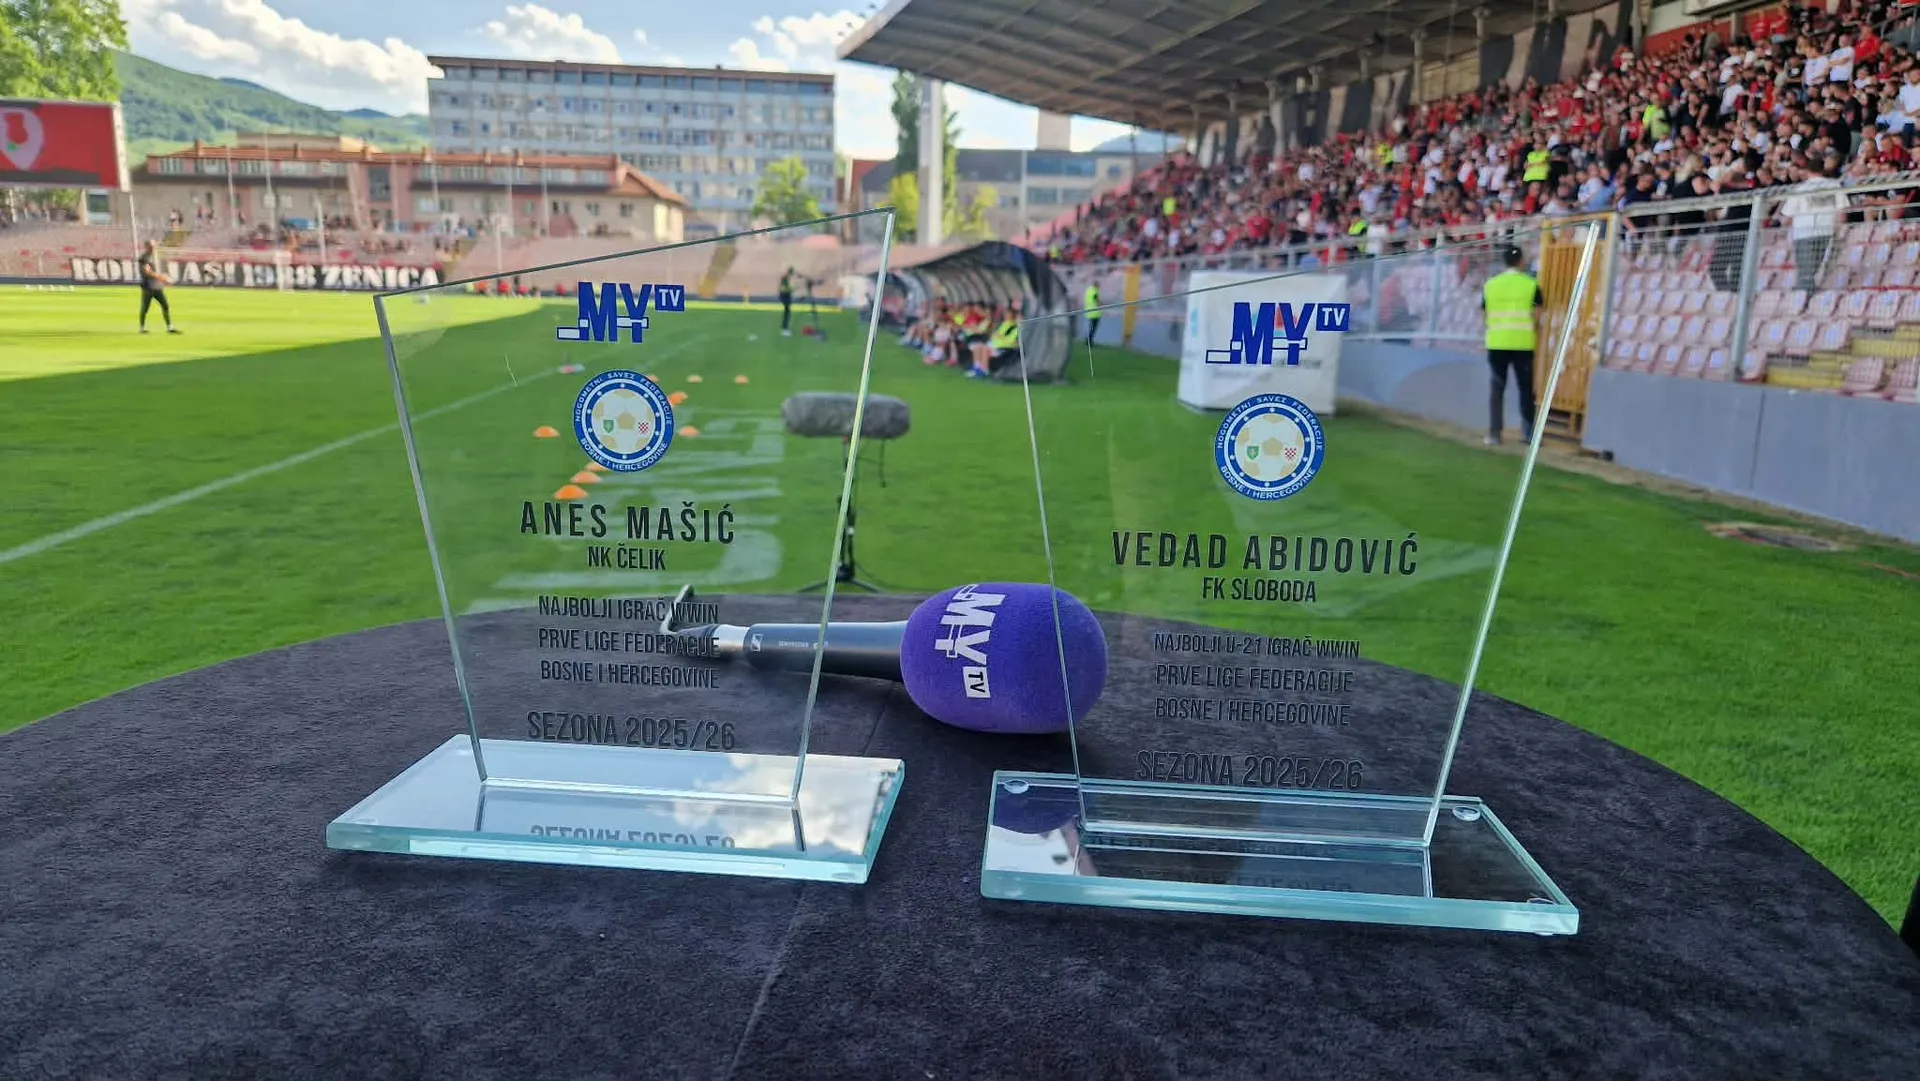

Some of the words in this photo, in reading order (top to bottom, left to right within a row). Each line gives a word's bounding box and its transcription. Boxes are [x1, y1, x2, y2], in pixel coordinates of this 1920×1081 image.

[321, 263, 439, 290] ZENICA
[657, 287, 682, 308] TV
[1319, 305, 1347, 329] TV
[575, 377, 602, 422] NOGOMETNI
[607, 372, 635, 380] SAVEZ
[640, 378, 673, 426] FEDERACIJE
[1217, 401, 1252, 449] NOGOMETNI
[1257, 395, 1288, 403] SAVEZ
[1292, 402, 1323, 451] FEDERACIJE
[580, 437, 606, 465] BOSNE
[611, 440, 668, 471] HERCEGOVINE
[1220, 465, 1246, 492] BOSNE
[1252, 467, 1316, 499] HERCEGOVINE
[521, 501, 607, 538] ANES
[626, 500, 734, 544] MAŠIĆ
[588, 545, 612, 568] NK
[616, 543, 666, 571] ČELIK
[1112, 531, 1227, 569] VEDAD
[1242, 533, 1418, 575] ABIDOVIĆ
[1202, 577, 1225, 599] FK
[1231, 577, 1317, 602] SLOBODA
[538, 595, 612, 619] NAJBOLJI
[617, 597, 666, 622] IGRAČ
[671, 602, 719, 624] WWIN
[539, 628, 580, 650] PRVE
[584, 630, 620, 652] LIGE
[624, 632, 721, 659] FEDERACIJE
[1154, 633, 1221, 653] NAJBOLJI
[1225, 637, 1262, 655] U-21
[1267, 635, 1312, 658] IGRAČ
[1316, 639, 1361, 660] WWIN
[541, 660, 593, 682] BOSNE
[599, 662, 604, 683] I
[608, 664, 720, 690] HERCEGOVINE
[966, 669, 988, 695] TV
[1156, 663, 1202, 686] PRVE
[1206, 665, 1245, 689] LIGE
[1249, 667, 1354, 693] FEDERACIJE
[1155, 697, 1214, 720] BOSNE
[1217, 700, 1223, 721] I
[1227, 700, 1351, 727] HERCEGOVINE
[527, 711, 619, 744] SEZONA
[624, 716, 736, 751] 2025/26
[1136, 750, 1234, 785] SEZONA
[1241, 755, 1365, 790] 2025/26
